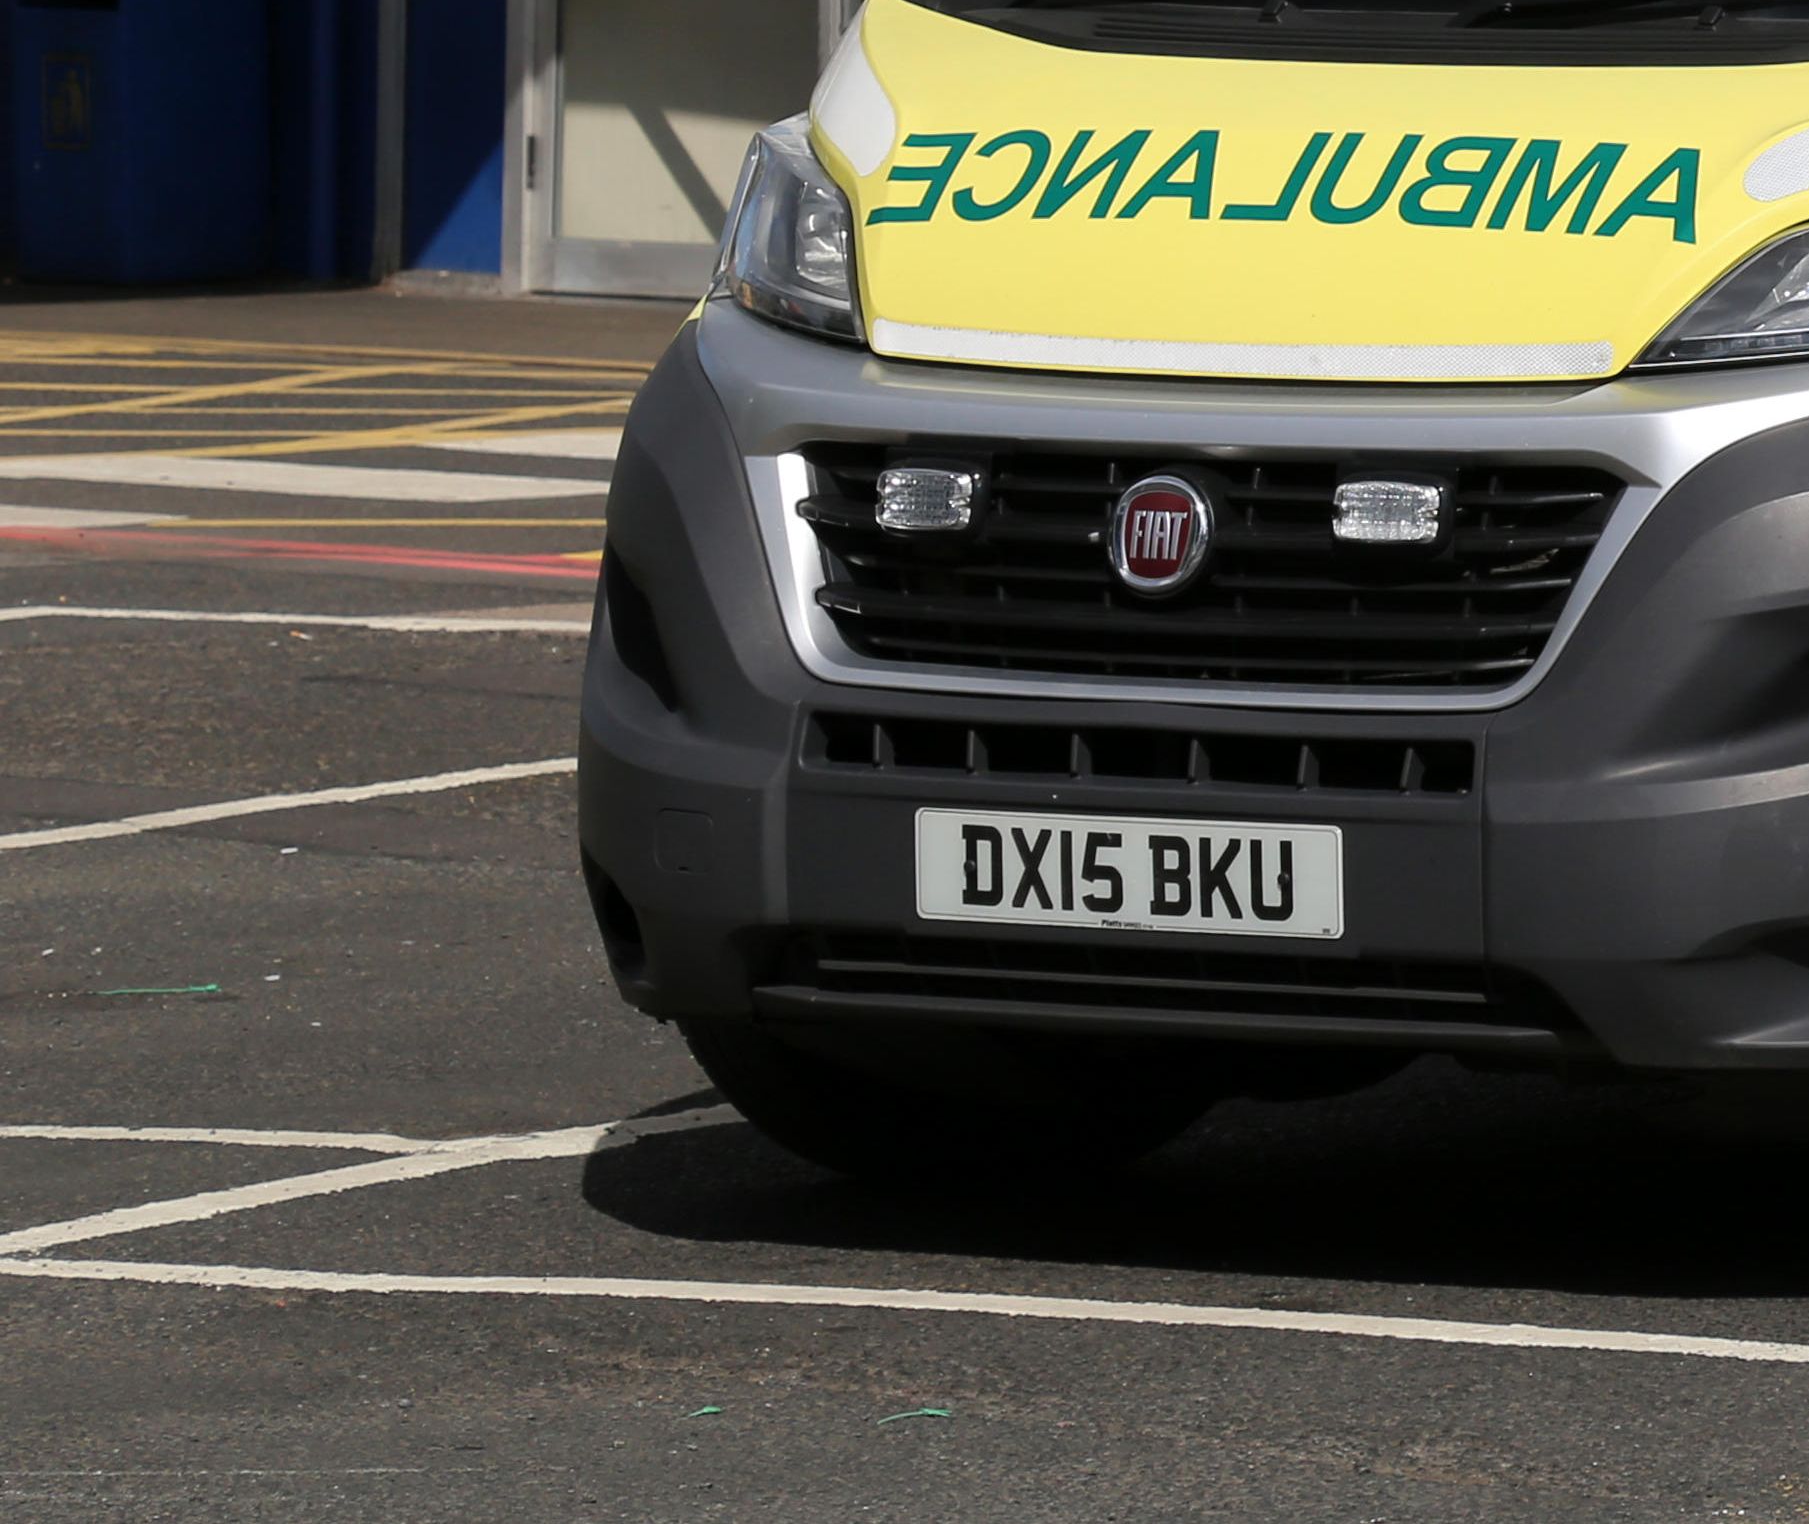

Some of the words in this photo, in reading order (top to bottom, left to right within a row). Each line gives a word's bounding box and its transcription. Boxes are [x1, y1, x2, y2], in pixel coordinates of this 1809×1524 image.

[1129, 510, 1188, 560] FIAT
[961, 824, 1124, 914] DX15
[1148, 834, 1295, 922] BKU
